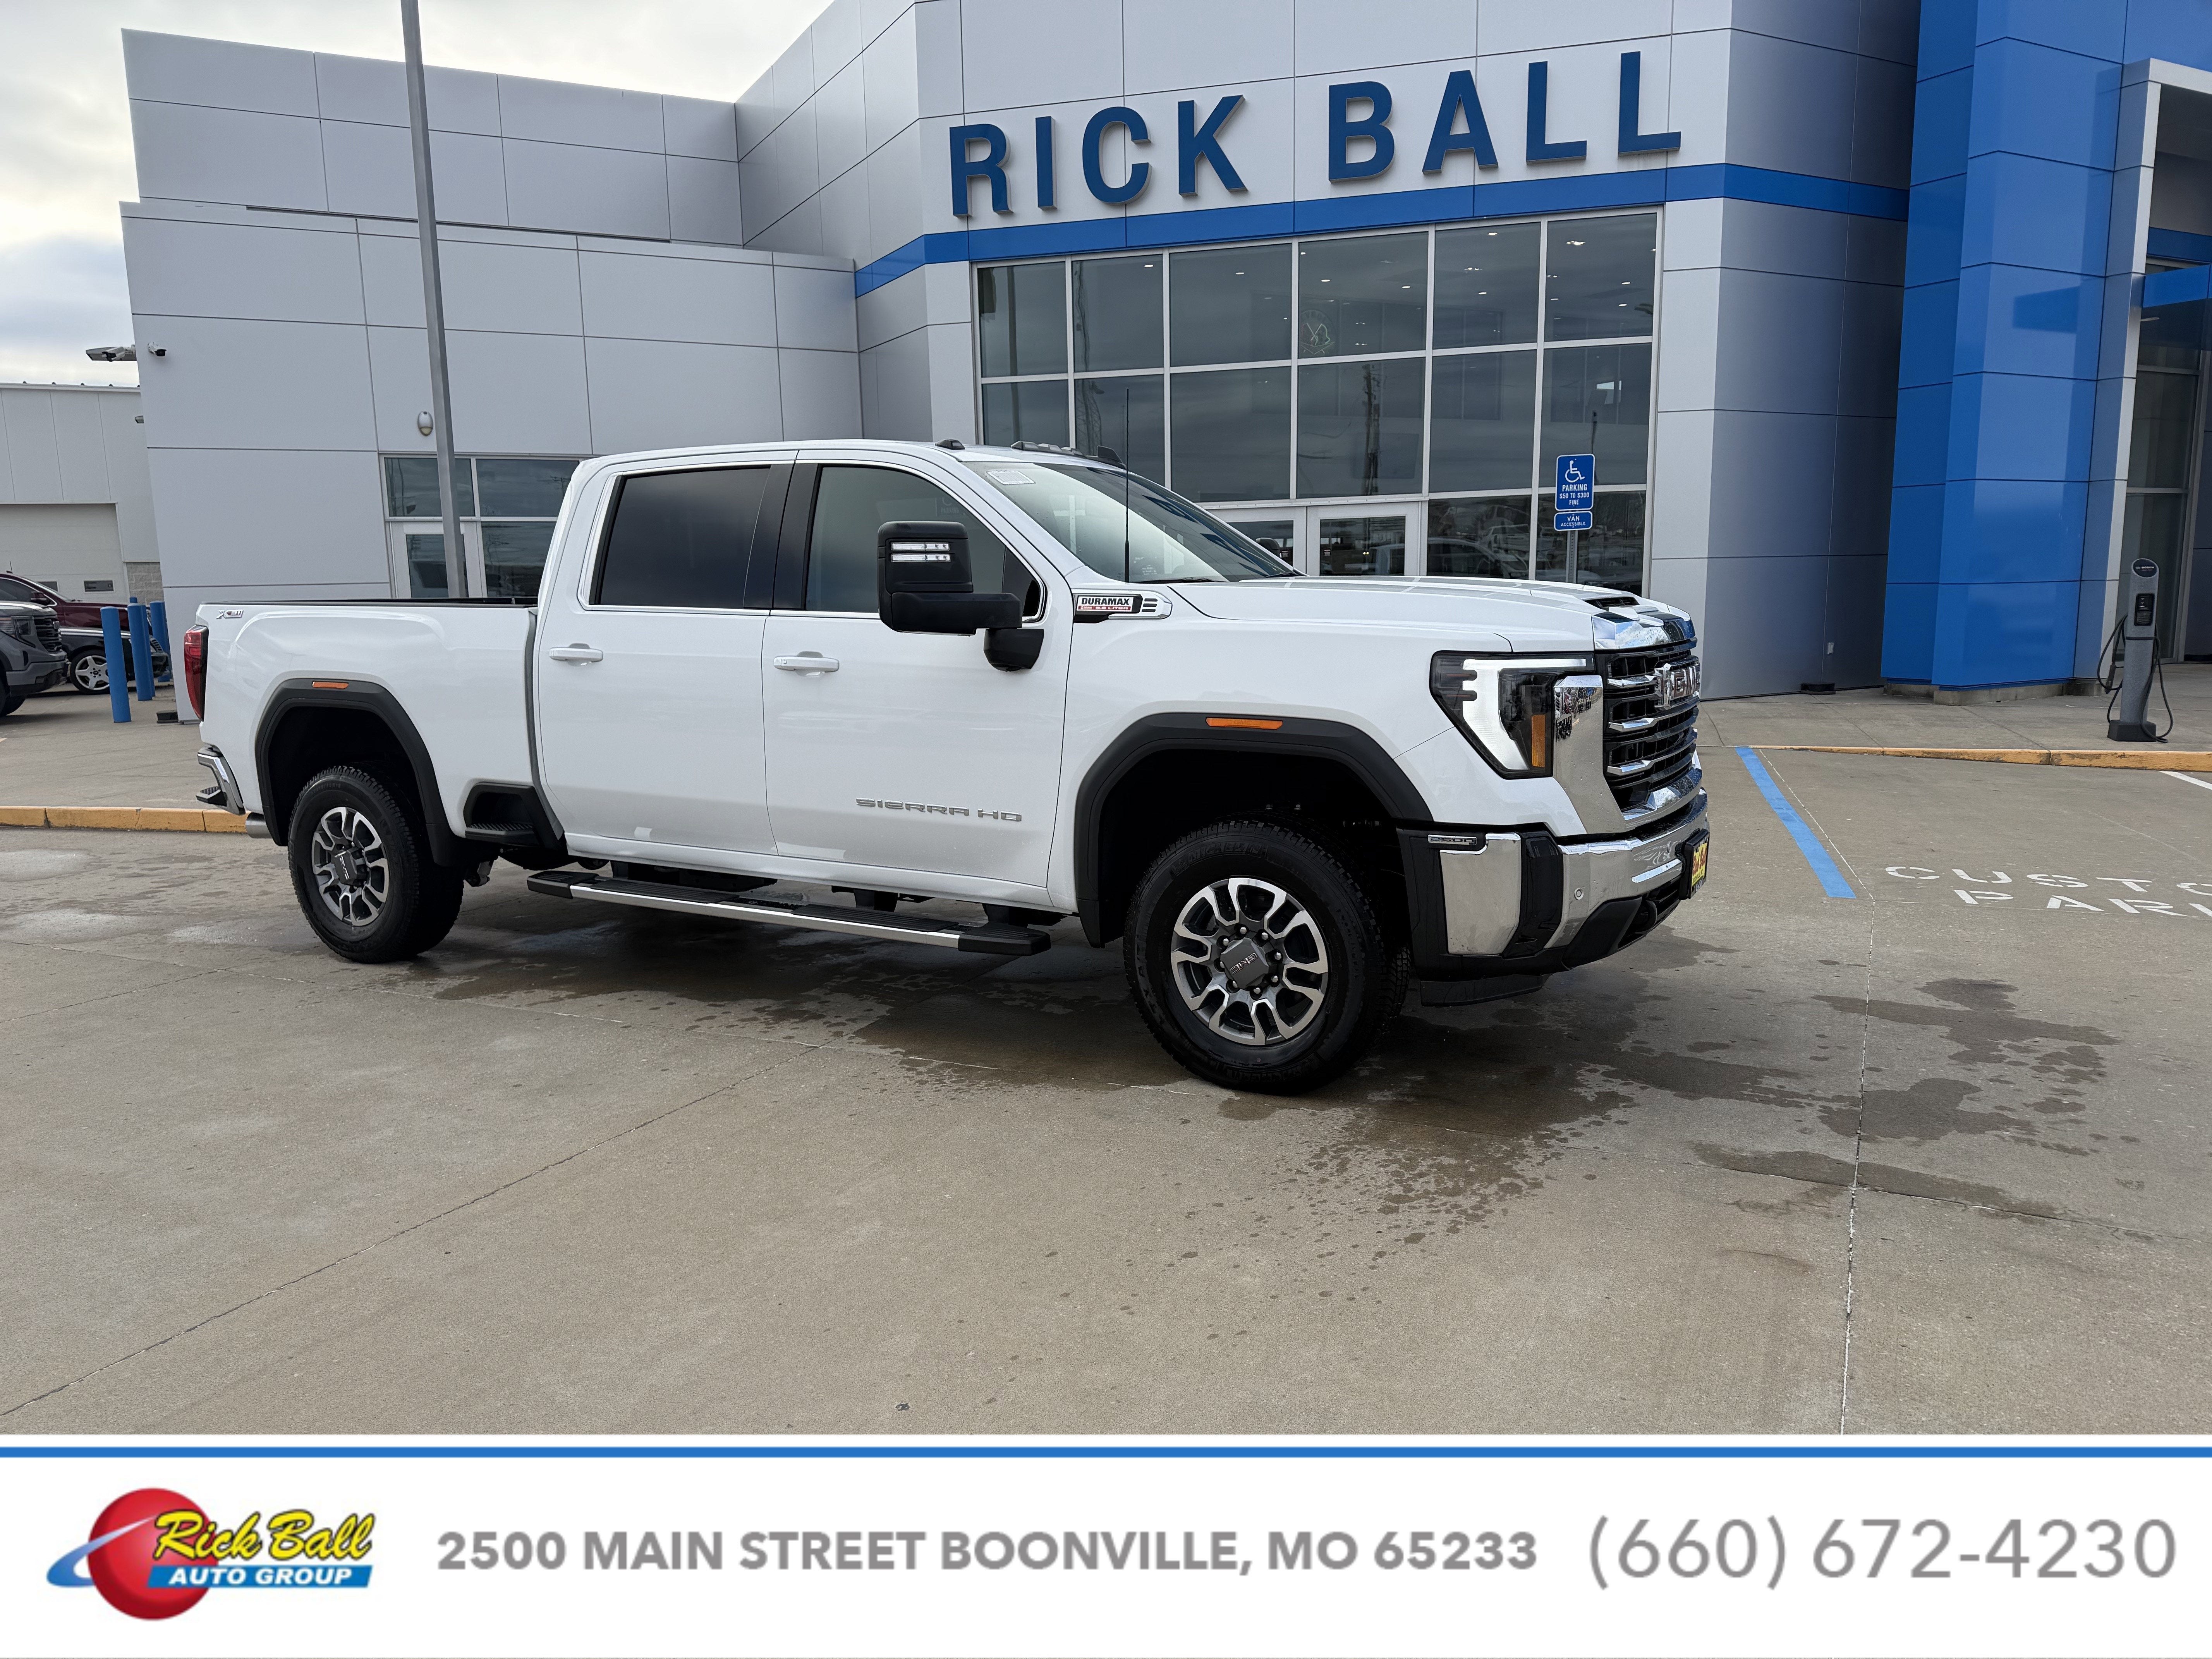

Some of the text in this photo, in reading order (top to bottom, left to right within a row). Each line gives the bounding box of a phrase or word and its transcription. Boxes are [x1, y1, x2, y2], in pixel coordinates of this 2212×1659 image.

[950, 51, 1681, 218] RICK BALL
[1562, 483, 1587, 492] PARKING
[856, 797, 1022, 822] SIERRA HD
[1230, 953, 1258, 975] GMC
